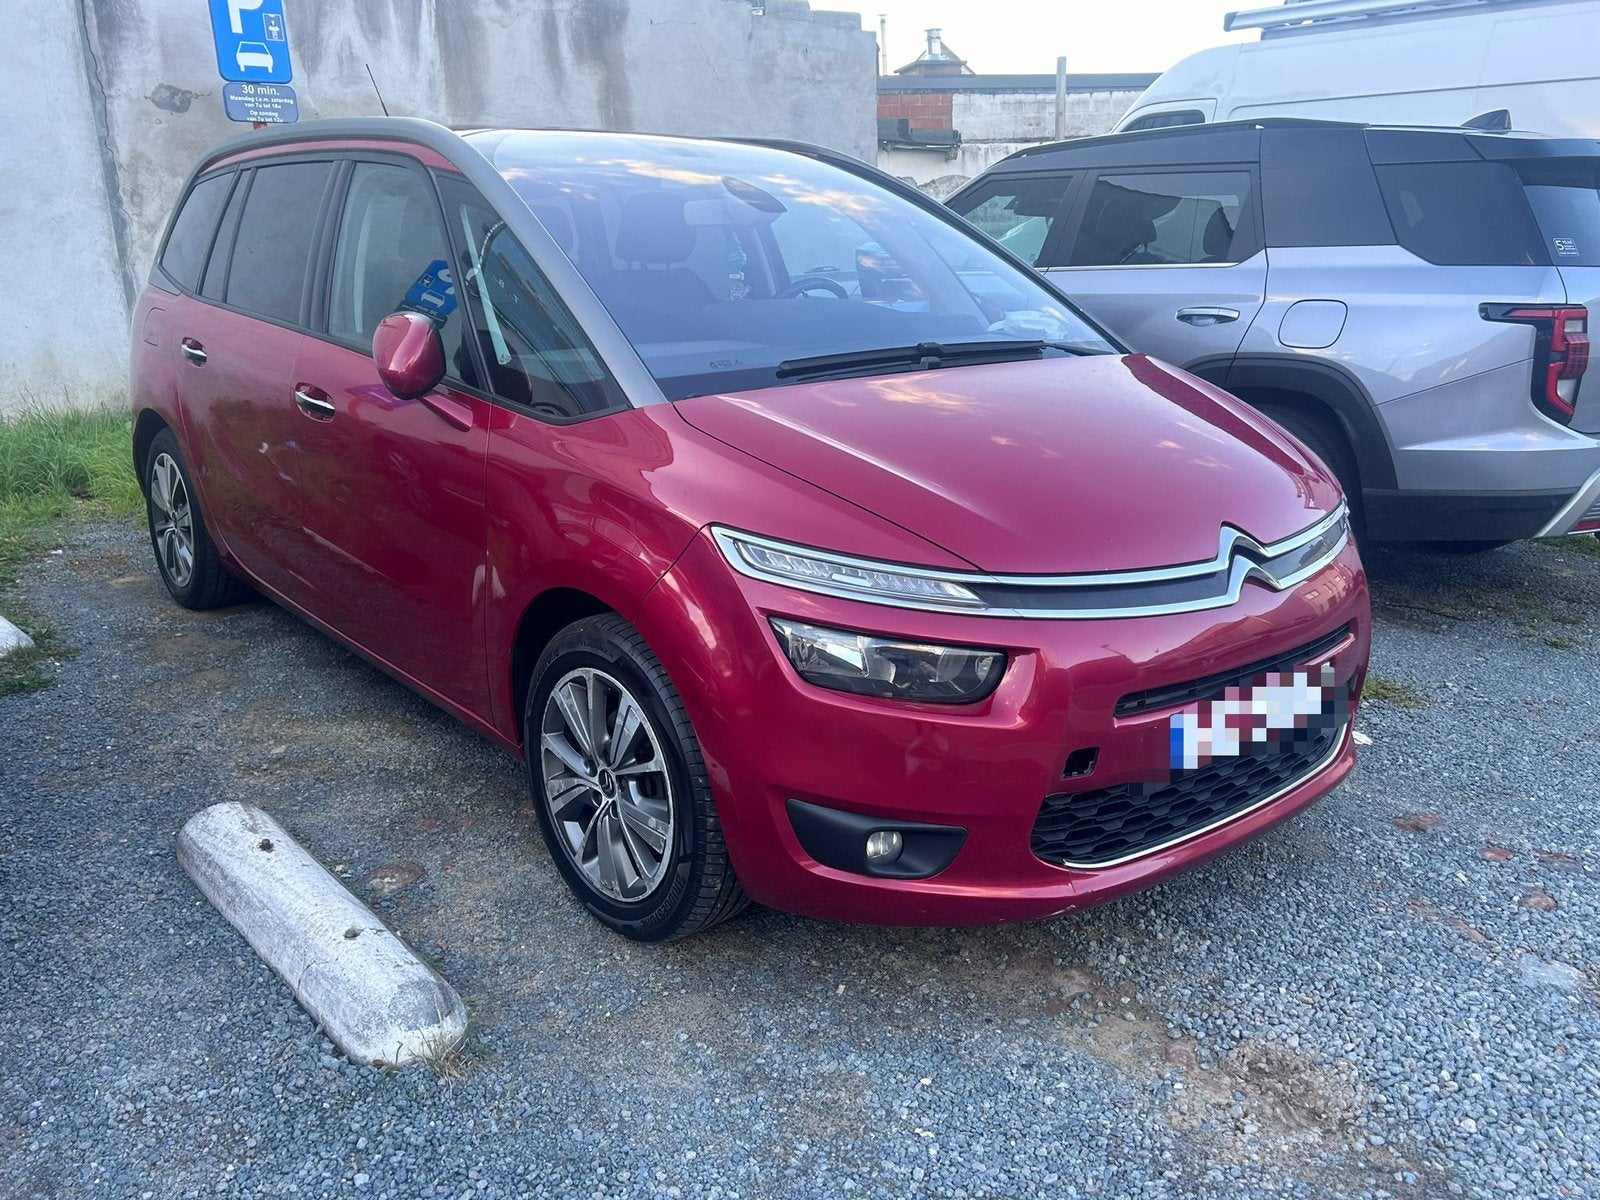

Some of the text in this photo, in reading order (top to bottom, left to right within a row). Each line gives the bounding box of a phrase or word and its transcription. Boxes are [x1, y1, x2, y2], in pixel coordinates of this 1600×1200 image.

[228, 0, 263, 34] P
[242, 85, 280, 95] 30 min.
